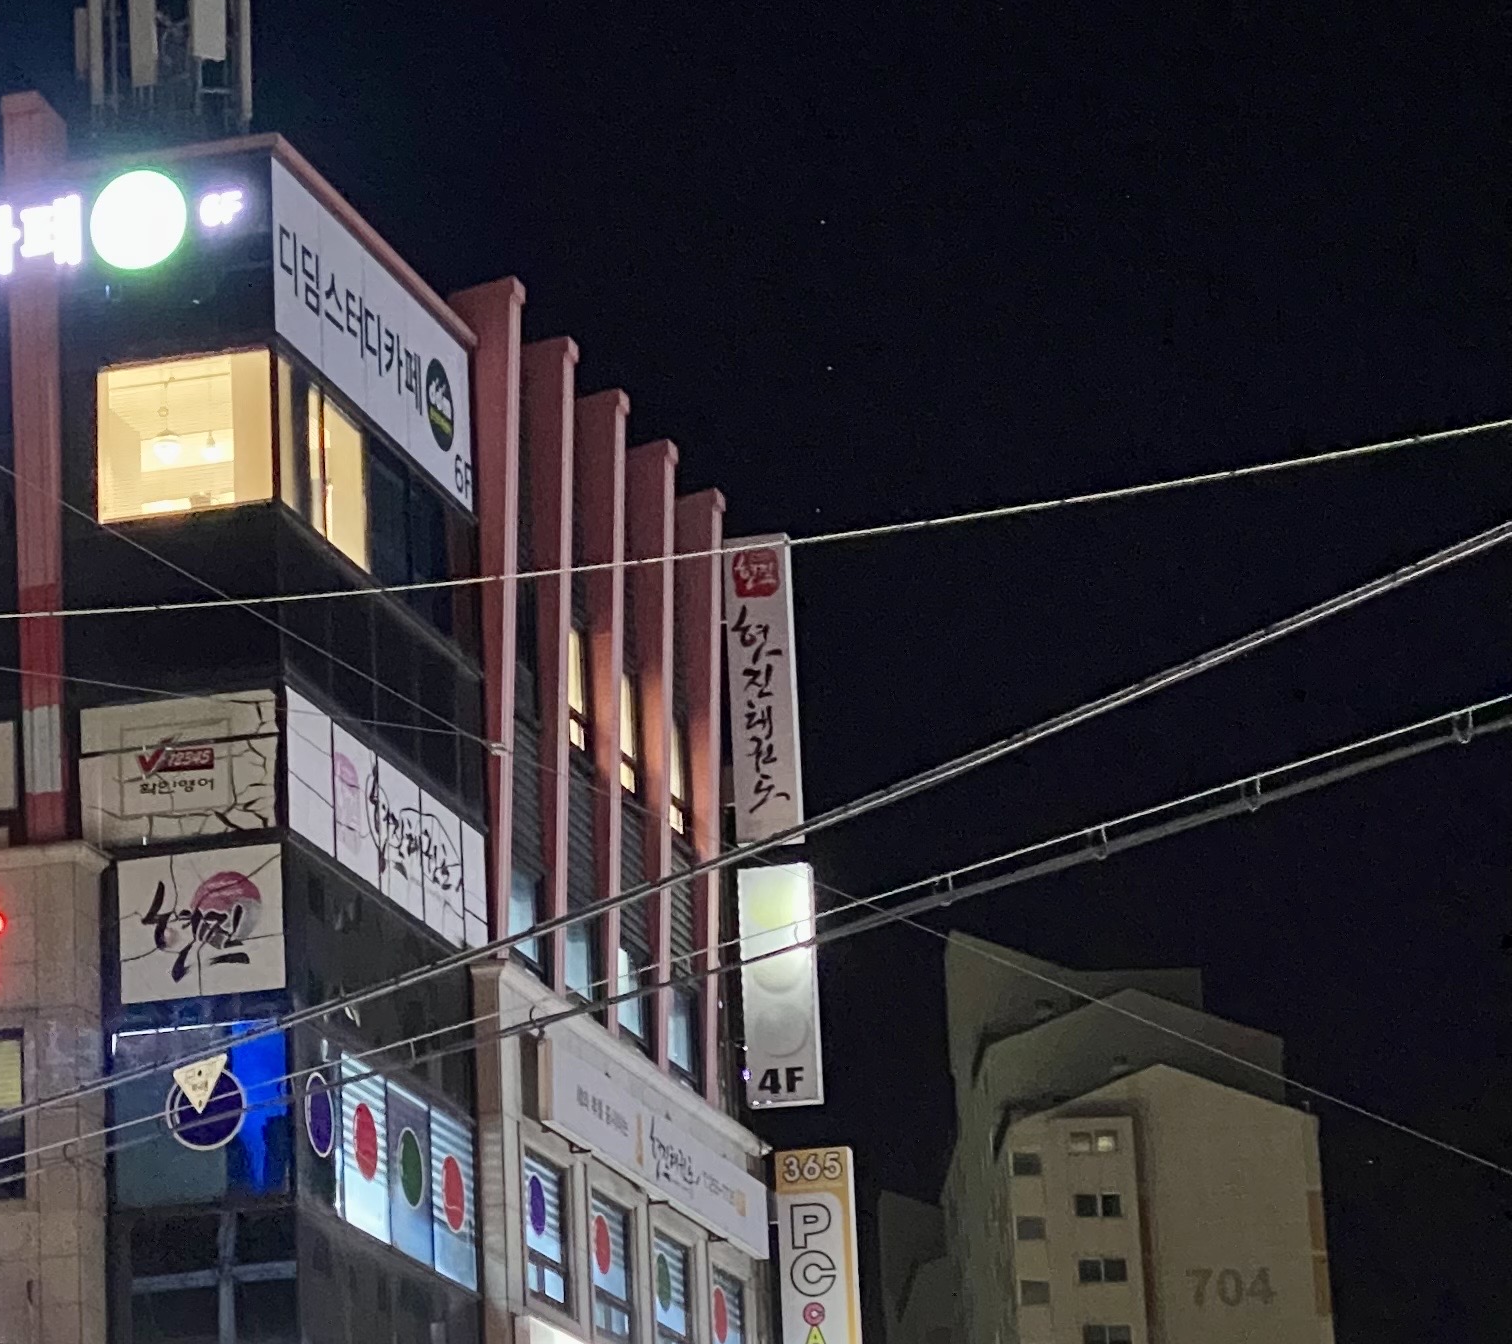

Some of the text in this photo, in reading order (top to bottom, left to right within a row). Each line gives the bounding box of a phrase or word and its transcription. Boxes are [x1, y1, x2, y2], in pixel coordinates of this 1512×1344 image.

[278, 224, 424, 417] 디딤스터디카페
[758, 1066, 805, 1096] 4F
[782, 1151, 843, 1184] 365
[1187, 1267, 1276, 1307] 704
